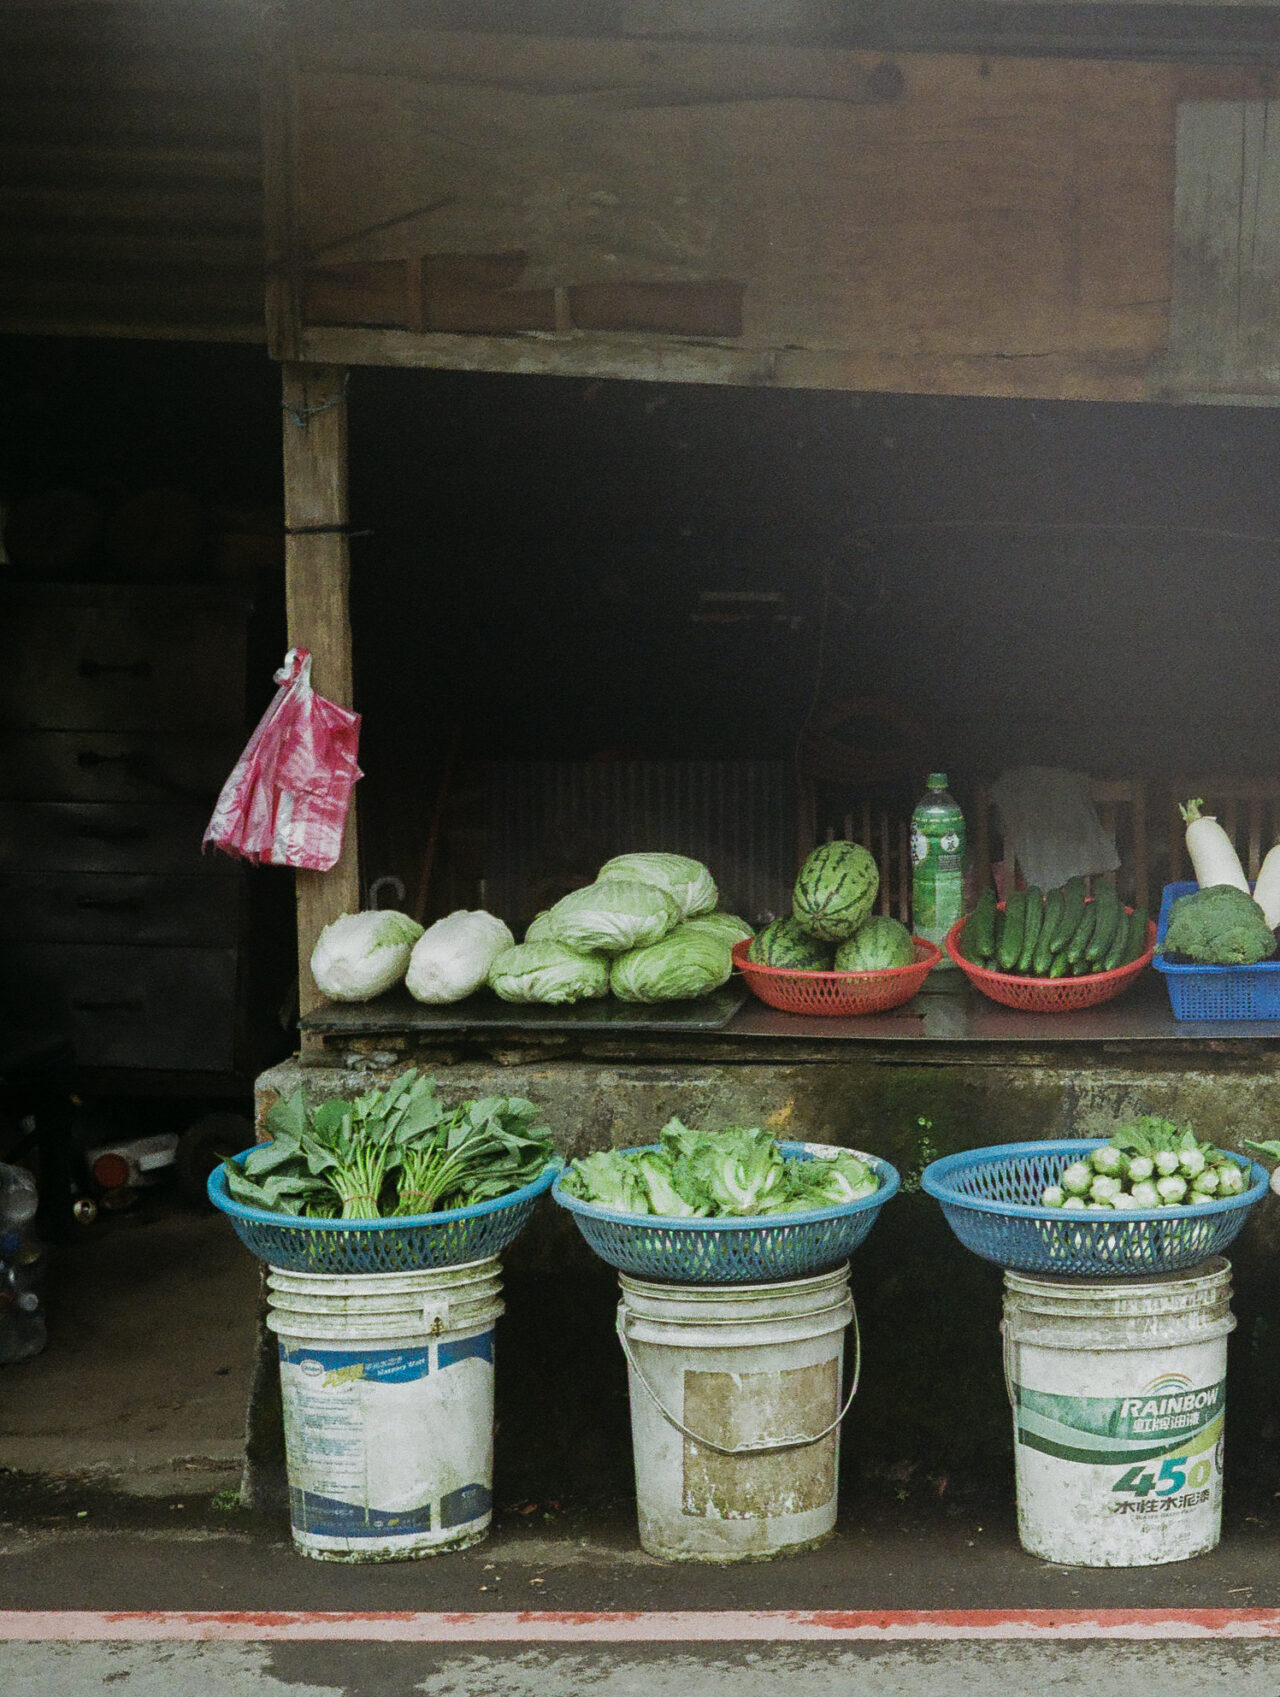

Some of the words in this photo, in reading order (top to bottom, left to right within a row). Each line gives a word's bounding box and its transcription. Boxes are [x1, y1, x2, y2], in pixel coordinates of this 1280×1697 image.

[1121, 1389, 1218, 1418] RAINBOW
[1112, 1456, 1212, 1497] 450
[1113, 1488, 1211, 1515] 水性水泥漆
